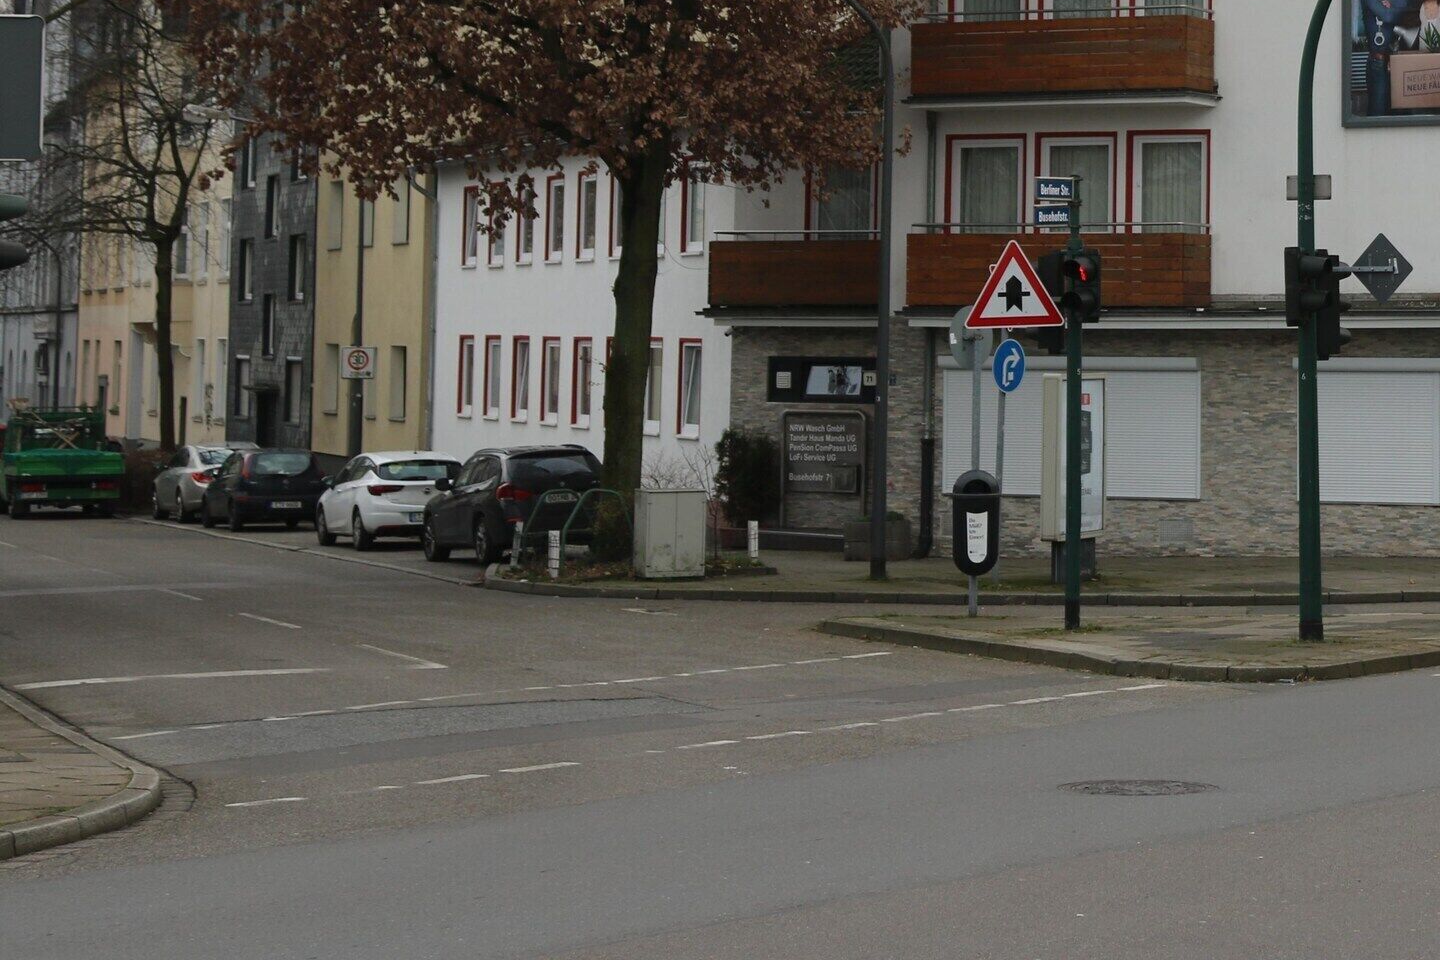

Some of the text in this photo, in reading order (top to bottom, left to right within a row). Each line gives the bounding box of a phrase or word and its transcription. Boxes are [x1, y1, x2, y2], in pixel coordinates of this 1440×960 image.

[1406, 83, 1427, 91] NEUE
[1040, 184, 1070, 195] Berliner Str.
[1301, 372, 1306, 381] 6
[846, 434, 856, 442] UG
